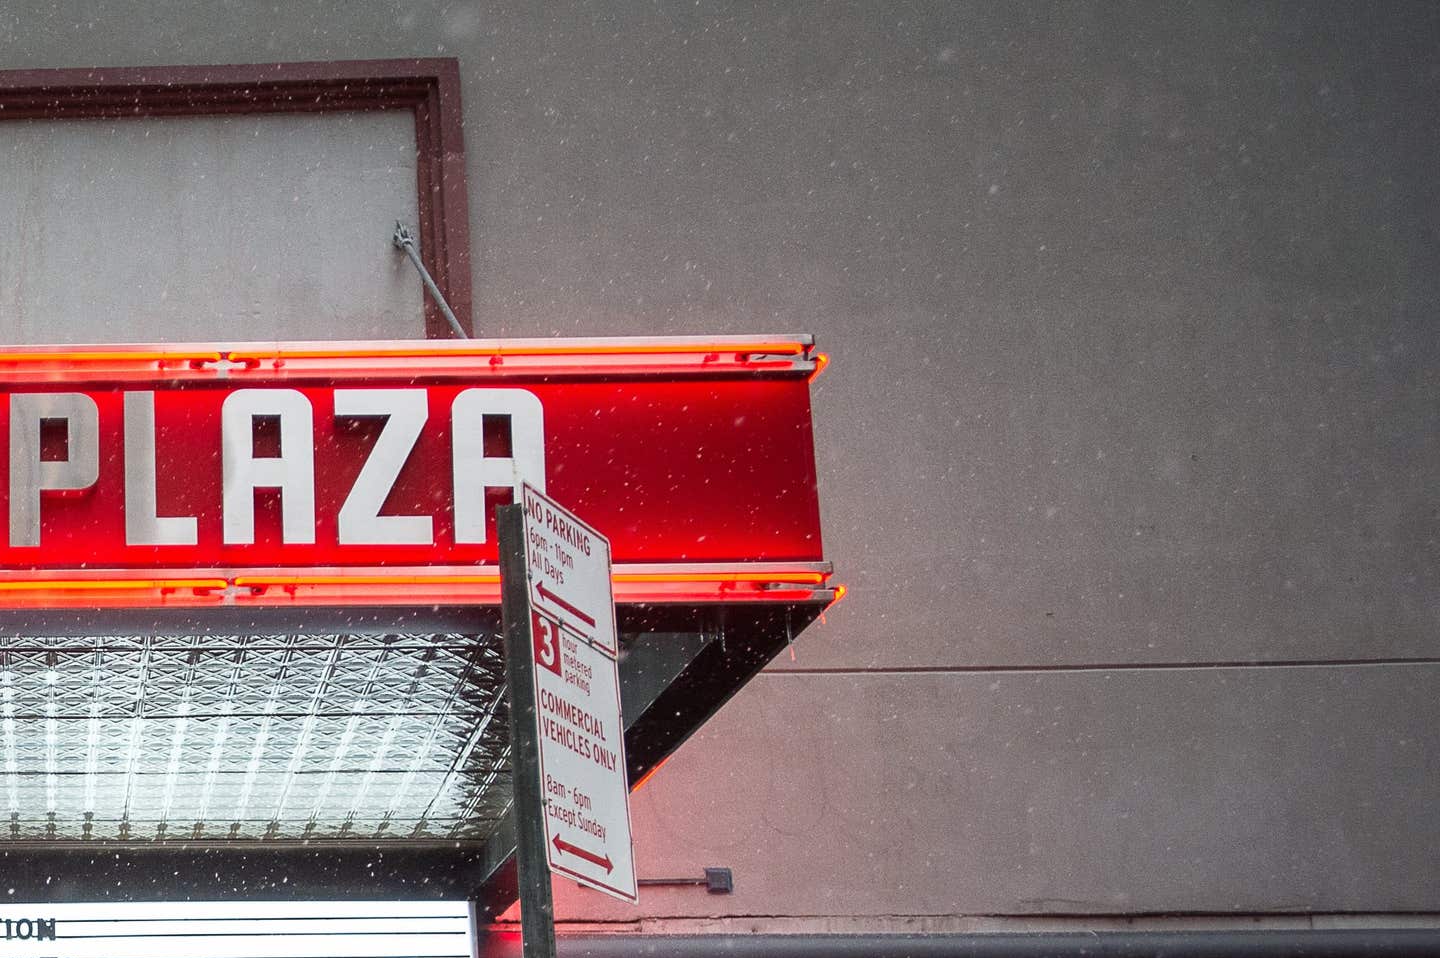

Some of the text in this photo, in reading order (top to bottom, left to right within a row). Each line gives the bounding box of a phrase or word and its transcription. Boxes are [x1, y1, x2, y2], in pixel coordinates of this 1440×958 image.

[8, 388, 547, 549] PLAZA
[527, 495, 591, 557] NO PARKING
[530, 526, 548, 553] 6pm
[555, 543, 574, 570] 11pm
[532, 551, 565, 585] All Days
[539, 616, 555, 667] 3
[562, 634, 578, 655] hour
[563, 653, 593, 680] metered
[564, 669, 591, 697] parking
[541, 688, 606, 741] COMMERCIAL
[543, 715, 617, 773] VEHICLES ONLY
[546, 774, 566, 800] 8am
[573, 787, 591, 811] 6pm
[548, 798, 606, 843] Except Sunday
